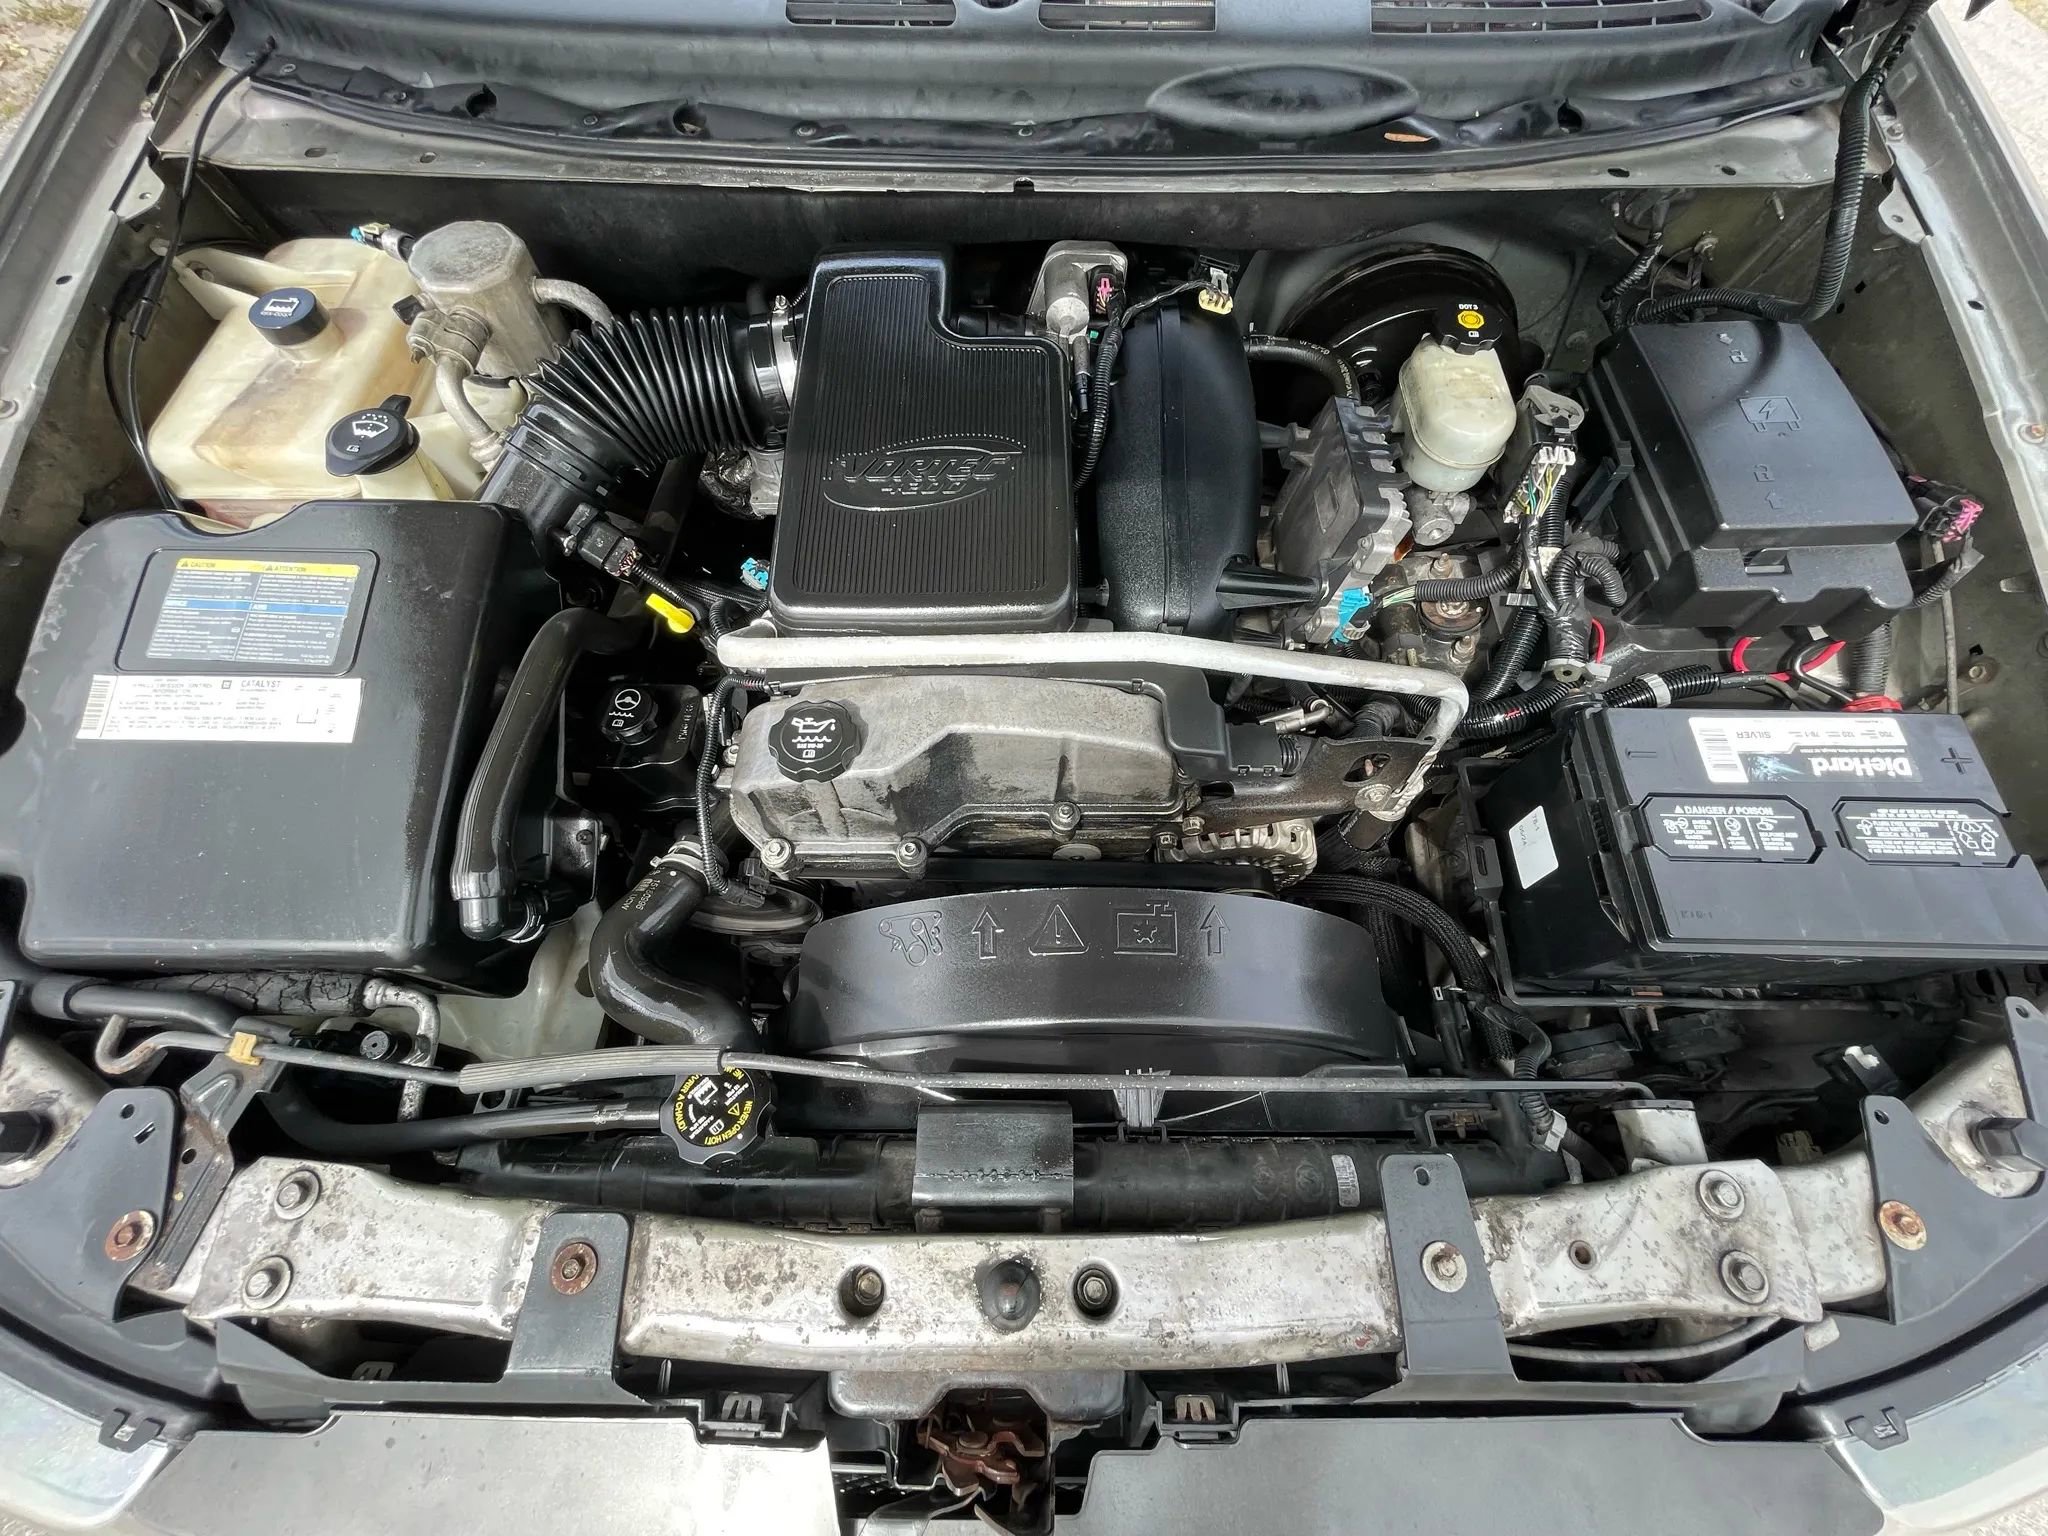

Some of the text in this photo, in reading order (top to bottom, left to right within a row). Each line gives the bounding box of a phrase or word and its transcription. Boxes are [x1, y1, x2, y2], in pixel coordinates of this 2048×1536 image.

[241, 679, 281, 688] CATALYST
[1736, 731, 1771, 739] SILVER
[1808, 756, 1913, 777] DieHard
[1684, 805, 1727, 815] DANGER
[1735, 806, 1774, 816] POISON
[732, 1068, 745, 1080] NE
[677, 1093, 686, 1101] A
[674, 1101, 688, 1133] CHAUD!
[704, 1100, 754, 1146] NEVER OPEN HOT!
